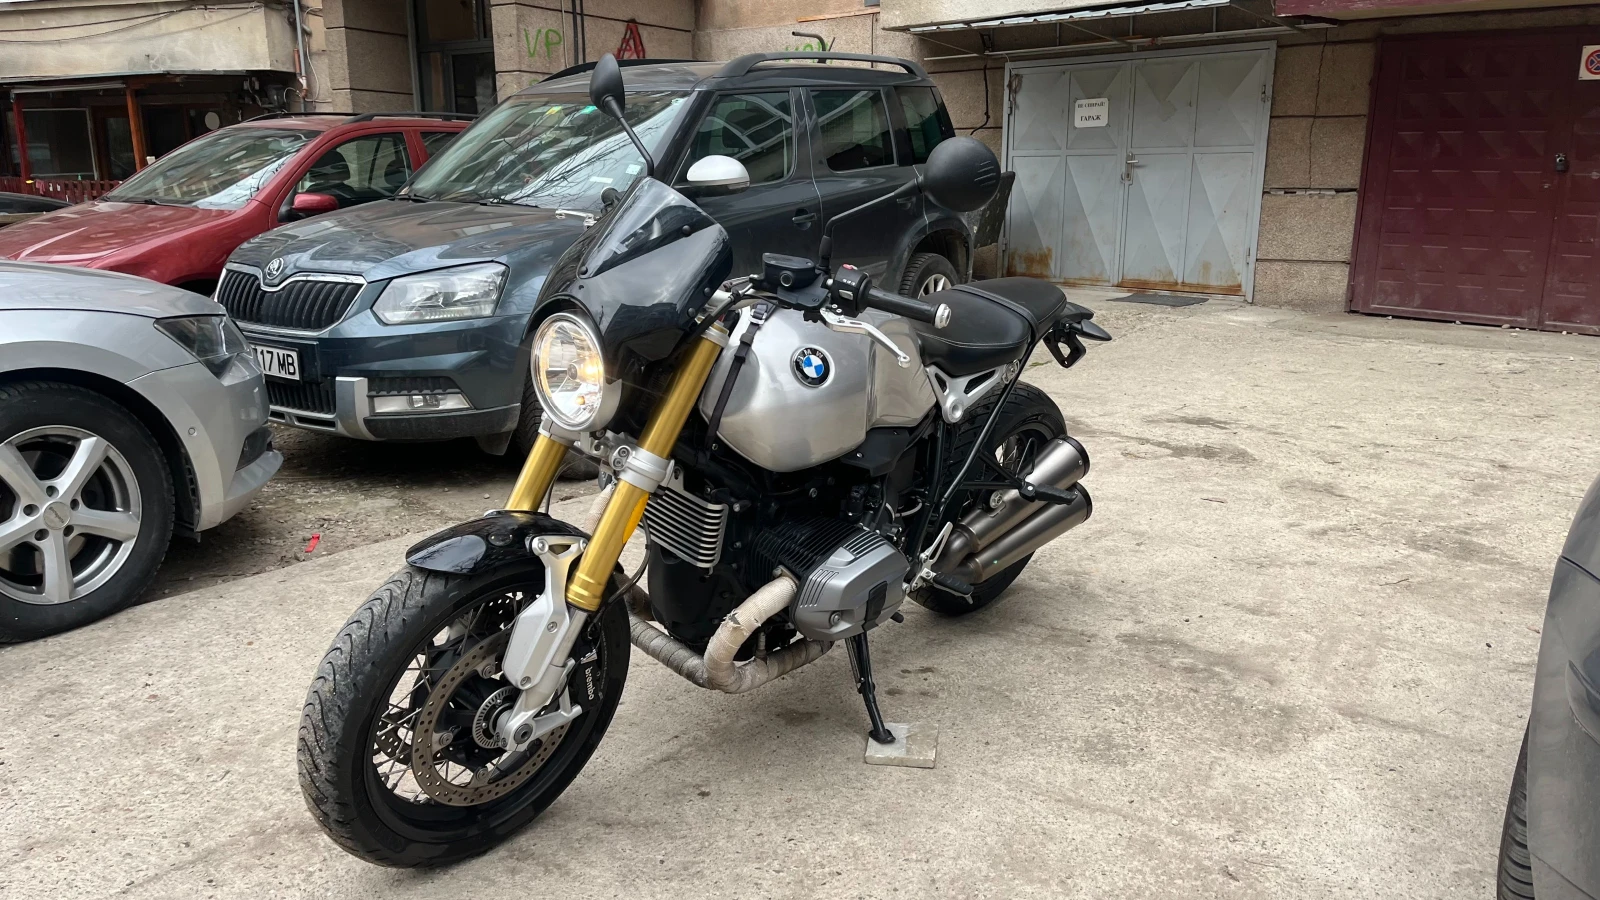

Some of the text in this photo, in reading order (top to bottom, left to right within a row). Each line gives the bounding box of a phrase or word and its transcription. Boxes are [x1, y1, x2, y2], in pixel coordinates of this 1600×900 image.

[523, 28, 562, 59] VP
[1080, 114, 1102, 122] ГАРАЖ
[276, 351, 296, 375] MB
[797, 348, 824, 369] BMW
[585, 666, 595, 700] brembo
